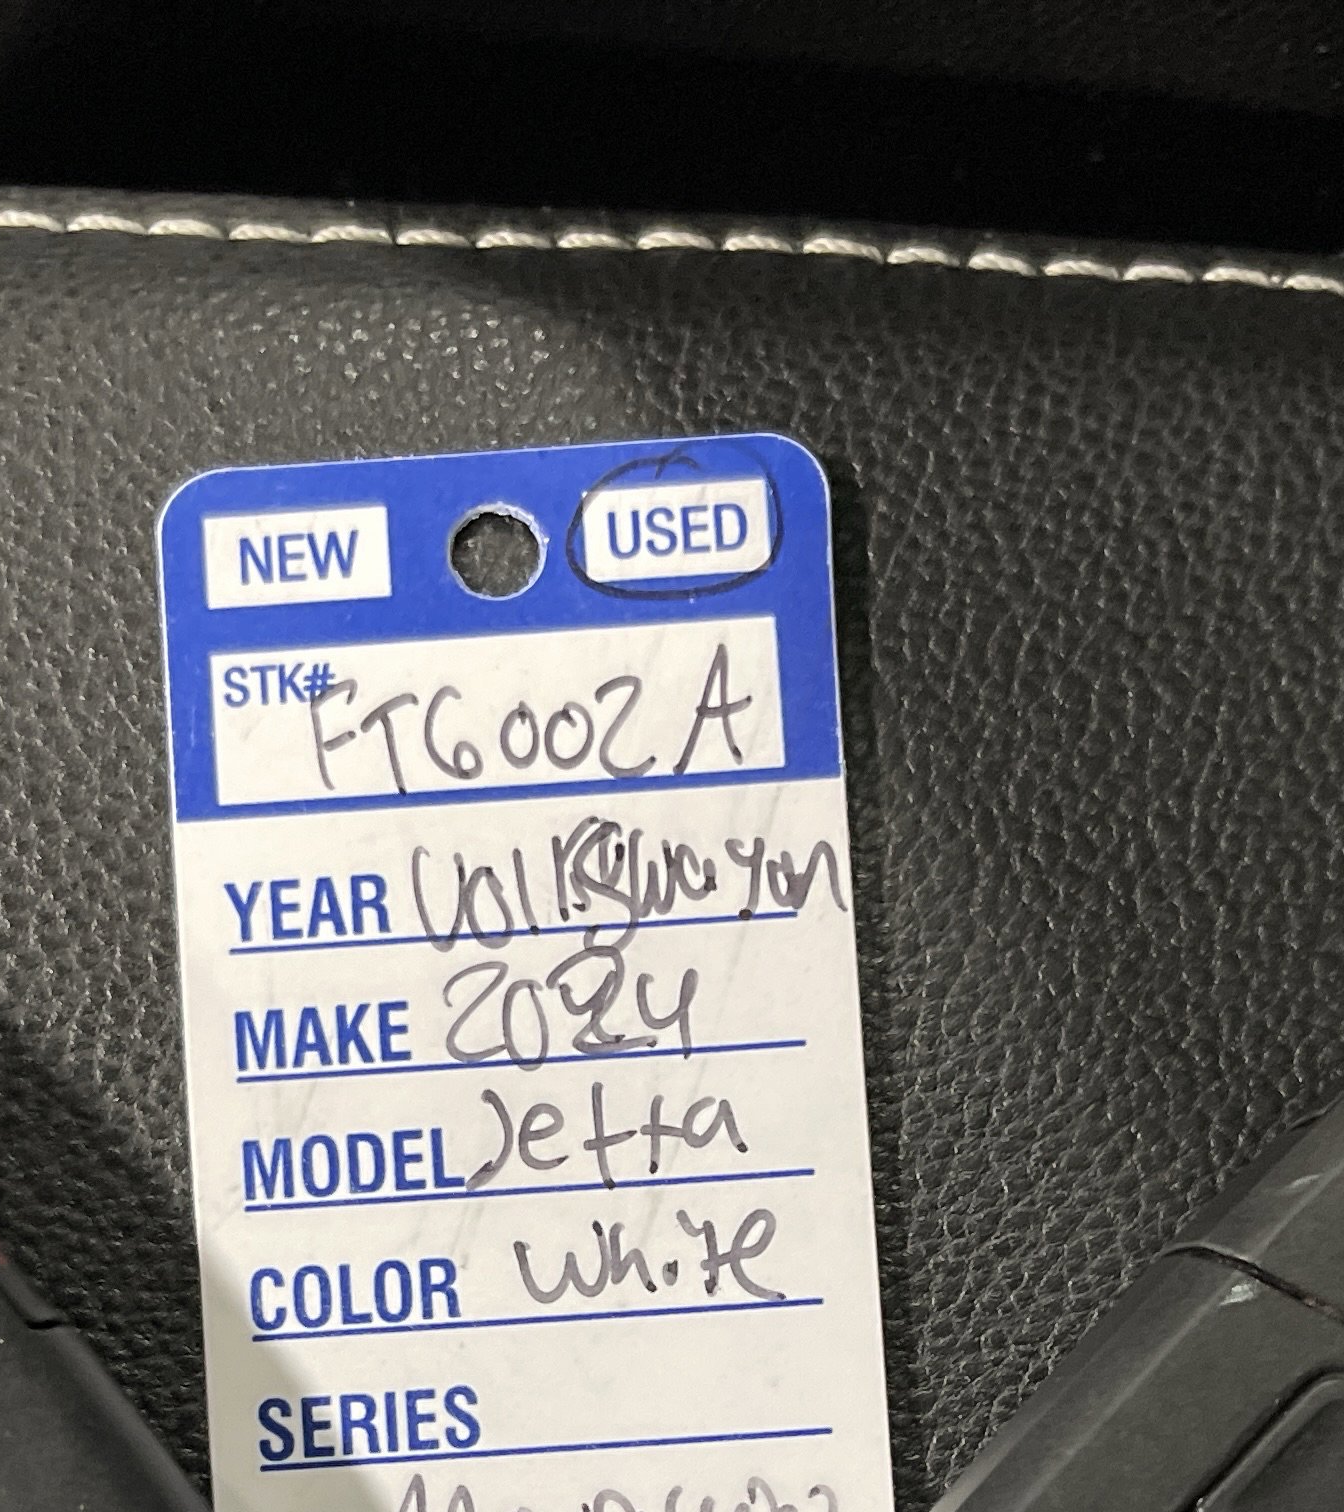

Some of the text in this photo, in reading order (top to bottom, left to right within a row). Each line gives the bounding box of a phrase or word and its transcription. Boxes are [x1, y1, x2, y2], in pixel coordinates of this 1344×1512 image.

[238, 529, 359, 586] NEW
[607, 502, 749, 558] USED
[222, 662, 336, 708] STK#
[223, 872, 390, 943] YEAR
[234, 999, 412, 1072] MAKE
[242, 1126, 465, 1200] MODEL
[250, 1256, 461, 1332] COLOR
[257, 1385, 482, 1462] SERIES
